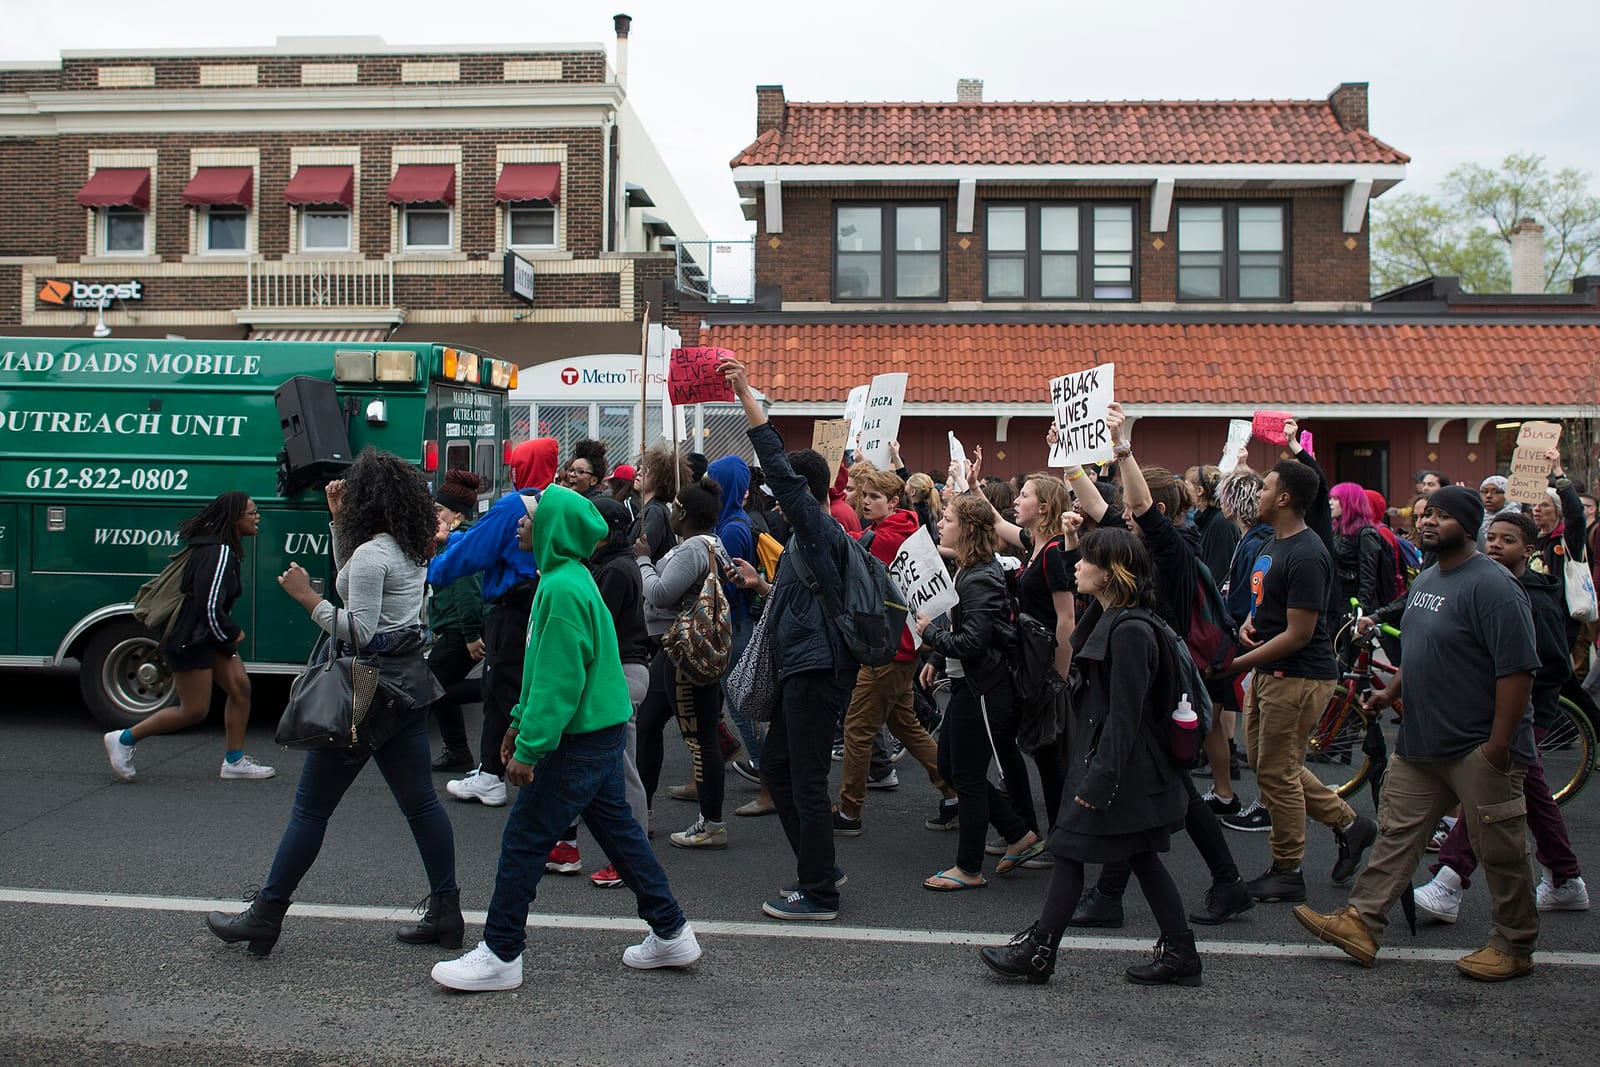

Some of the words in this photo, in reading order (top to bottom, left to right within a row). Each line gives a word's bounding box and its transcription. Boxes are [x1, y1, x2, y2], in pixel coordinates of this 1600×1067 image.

[73, 281, 141, 299] boost
[74, 299, 110, 308] mobe
[61, 352, 138, 373] DADS
[144, 353, 261, 375] MOBILE
[583, 368, 626, 384] Metro
[1052, 369, 1099, 405] #BLACK
[1057, 397, 1089, 430] LIVES
[171, 414, 248, 437] UNIT
[1522, 426, 1557, 439] BLACK
[1053, 419, 1106, 458] MATTER
[26, 467, 188, 490] 612-822-0802
[1514, 463, 1551, 474] MATTER!
[94, 528, 180, 546] WISDOM
[1407, 591, 1446, 612] JUSTICE
